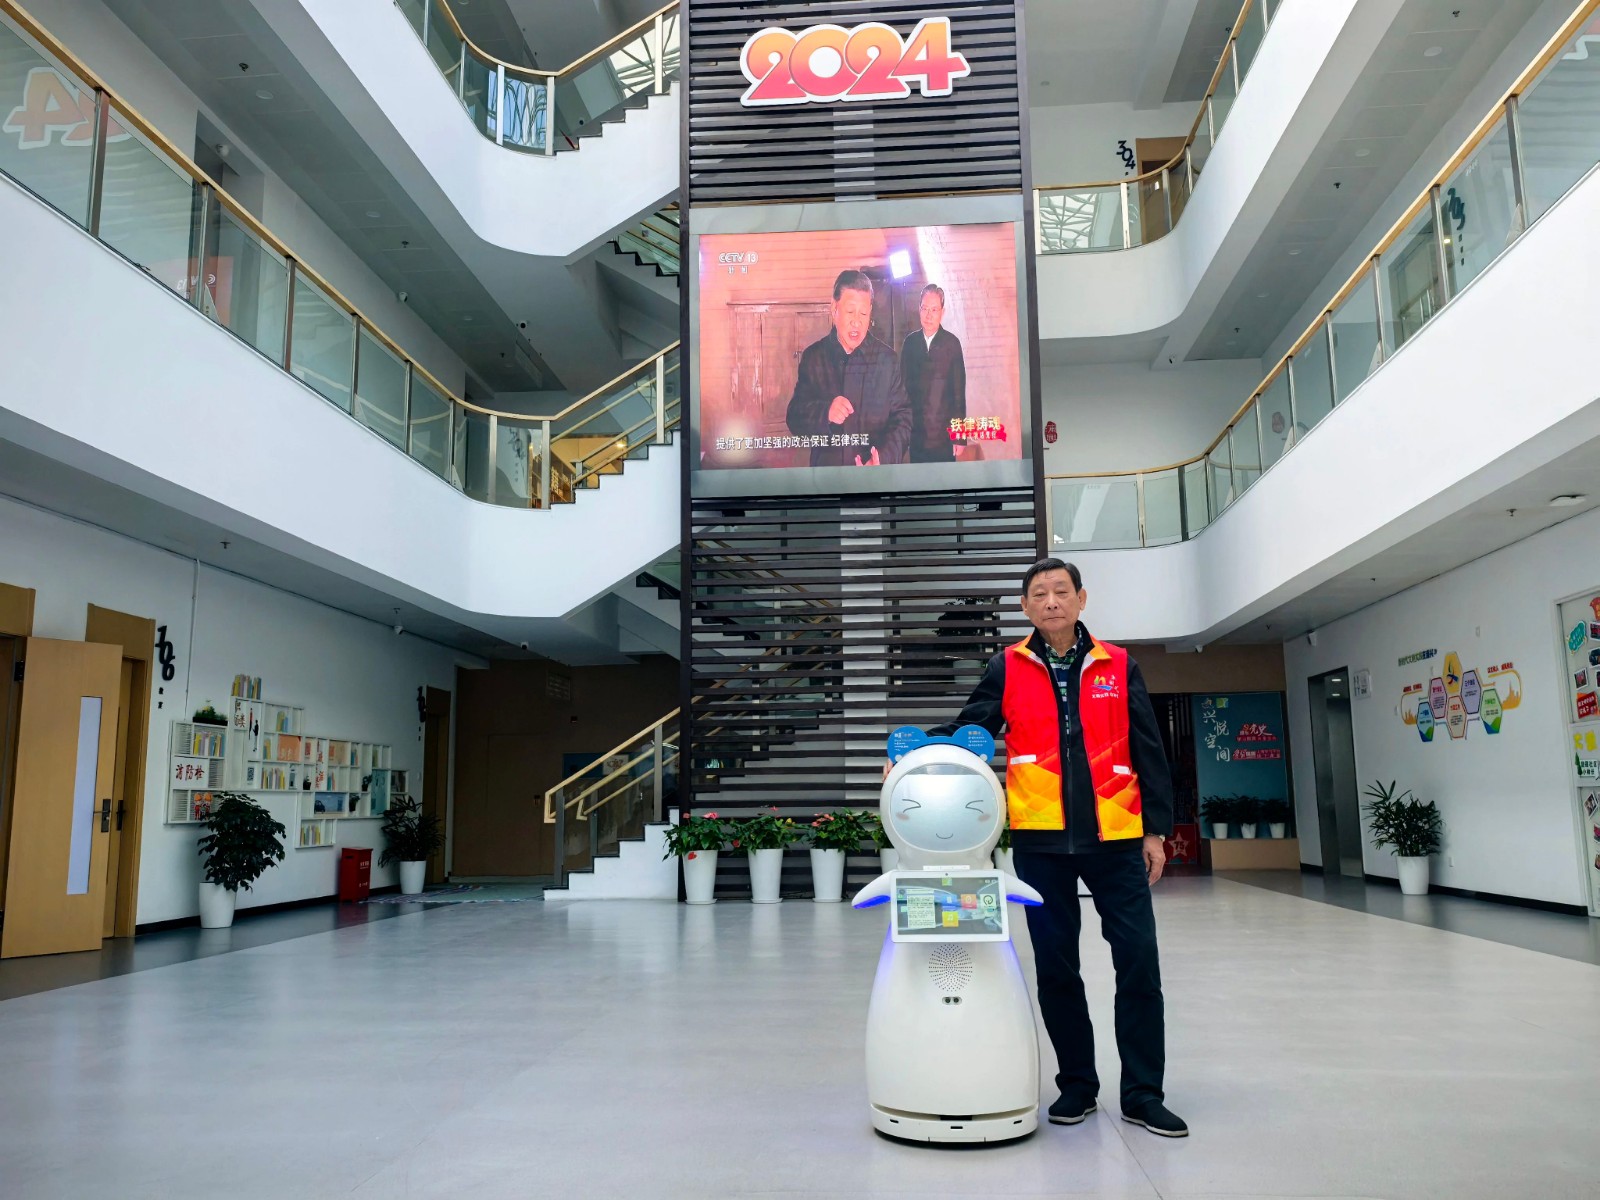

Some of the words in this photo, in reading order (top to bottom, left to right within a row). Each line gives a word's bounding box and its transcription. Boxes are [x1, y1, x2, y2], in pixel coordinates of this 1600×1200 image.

[740, 17, 971, 107] 2024
[1116, 140, 1136, 170] 304
[719, 252, 744, 263] CCTV
[950, 416, 1000, 432] 铁律铸魂
[716, 435, 829, 450] 提供了更加坚强的政治保证
[831, 433, 869, 447] 纪律保证
[155, 625, 176, 681] 106
[1173, 840, 1185, 850] 75
